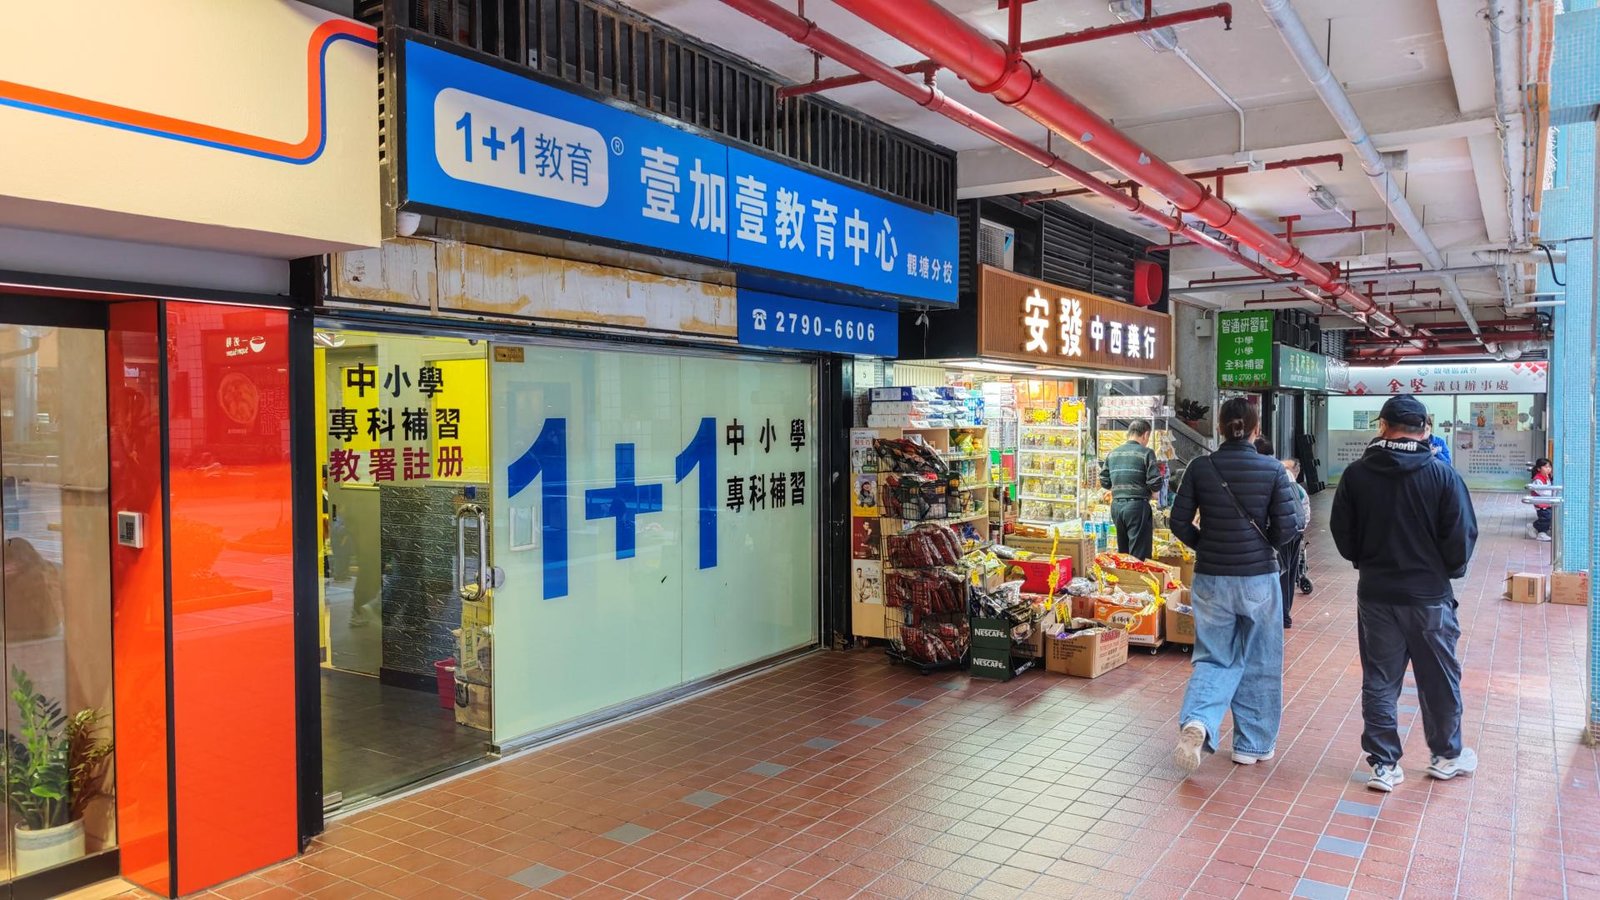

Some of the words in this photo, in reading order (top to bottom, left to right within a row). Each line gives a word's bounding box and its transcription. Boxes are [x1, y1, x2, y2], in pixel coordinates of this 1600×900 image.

[456, 111, 592, 187] 1+1教育
[640, 146, 898, 272] 壹加壹教育中心
[907, 253, 953, 284] 觀塘分校
[775, 311, 875, 342] 2790-6606
[1024, 288, 1083, 357] 安發
[1090, 314, 1156, 359] 中西藥行
[1234, 336, 1254, 345] 中學
[1224, 359, 1265, 371] 全科補習
[1234, 346, 1254, 355] 小學
[346, 362, 444, 399] 中小學
[328, 407, 461, 443] 專科補習
[726, 418, 806, 456] 中小學
[1387, 441, 1418, 452] sportif
[726, 471, 806, 514] 專科補習
